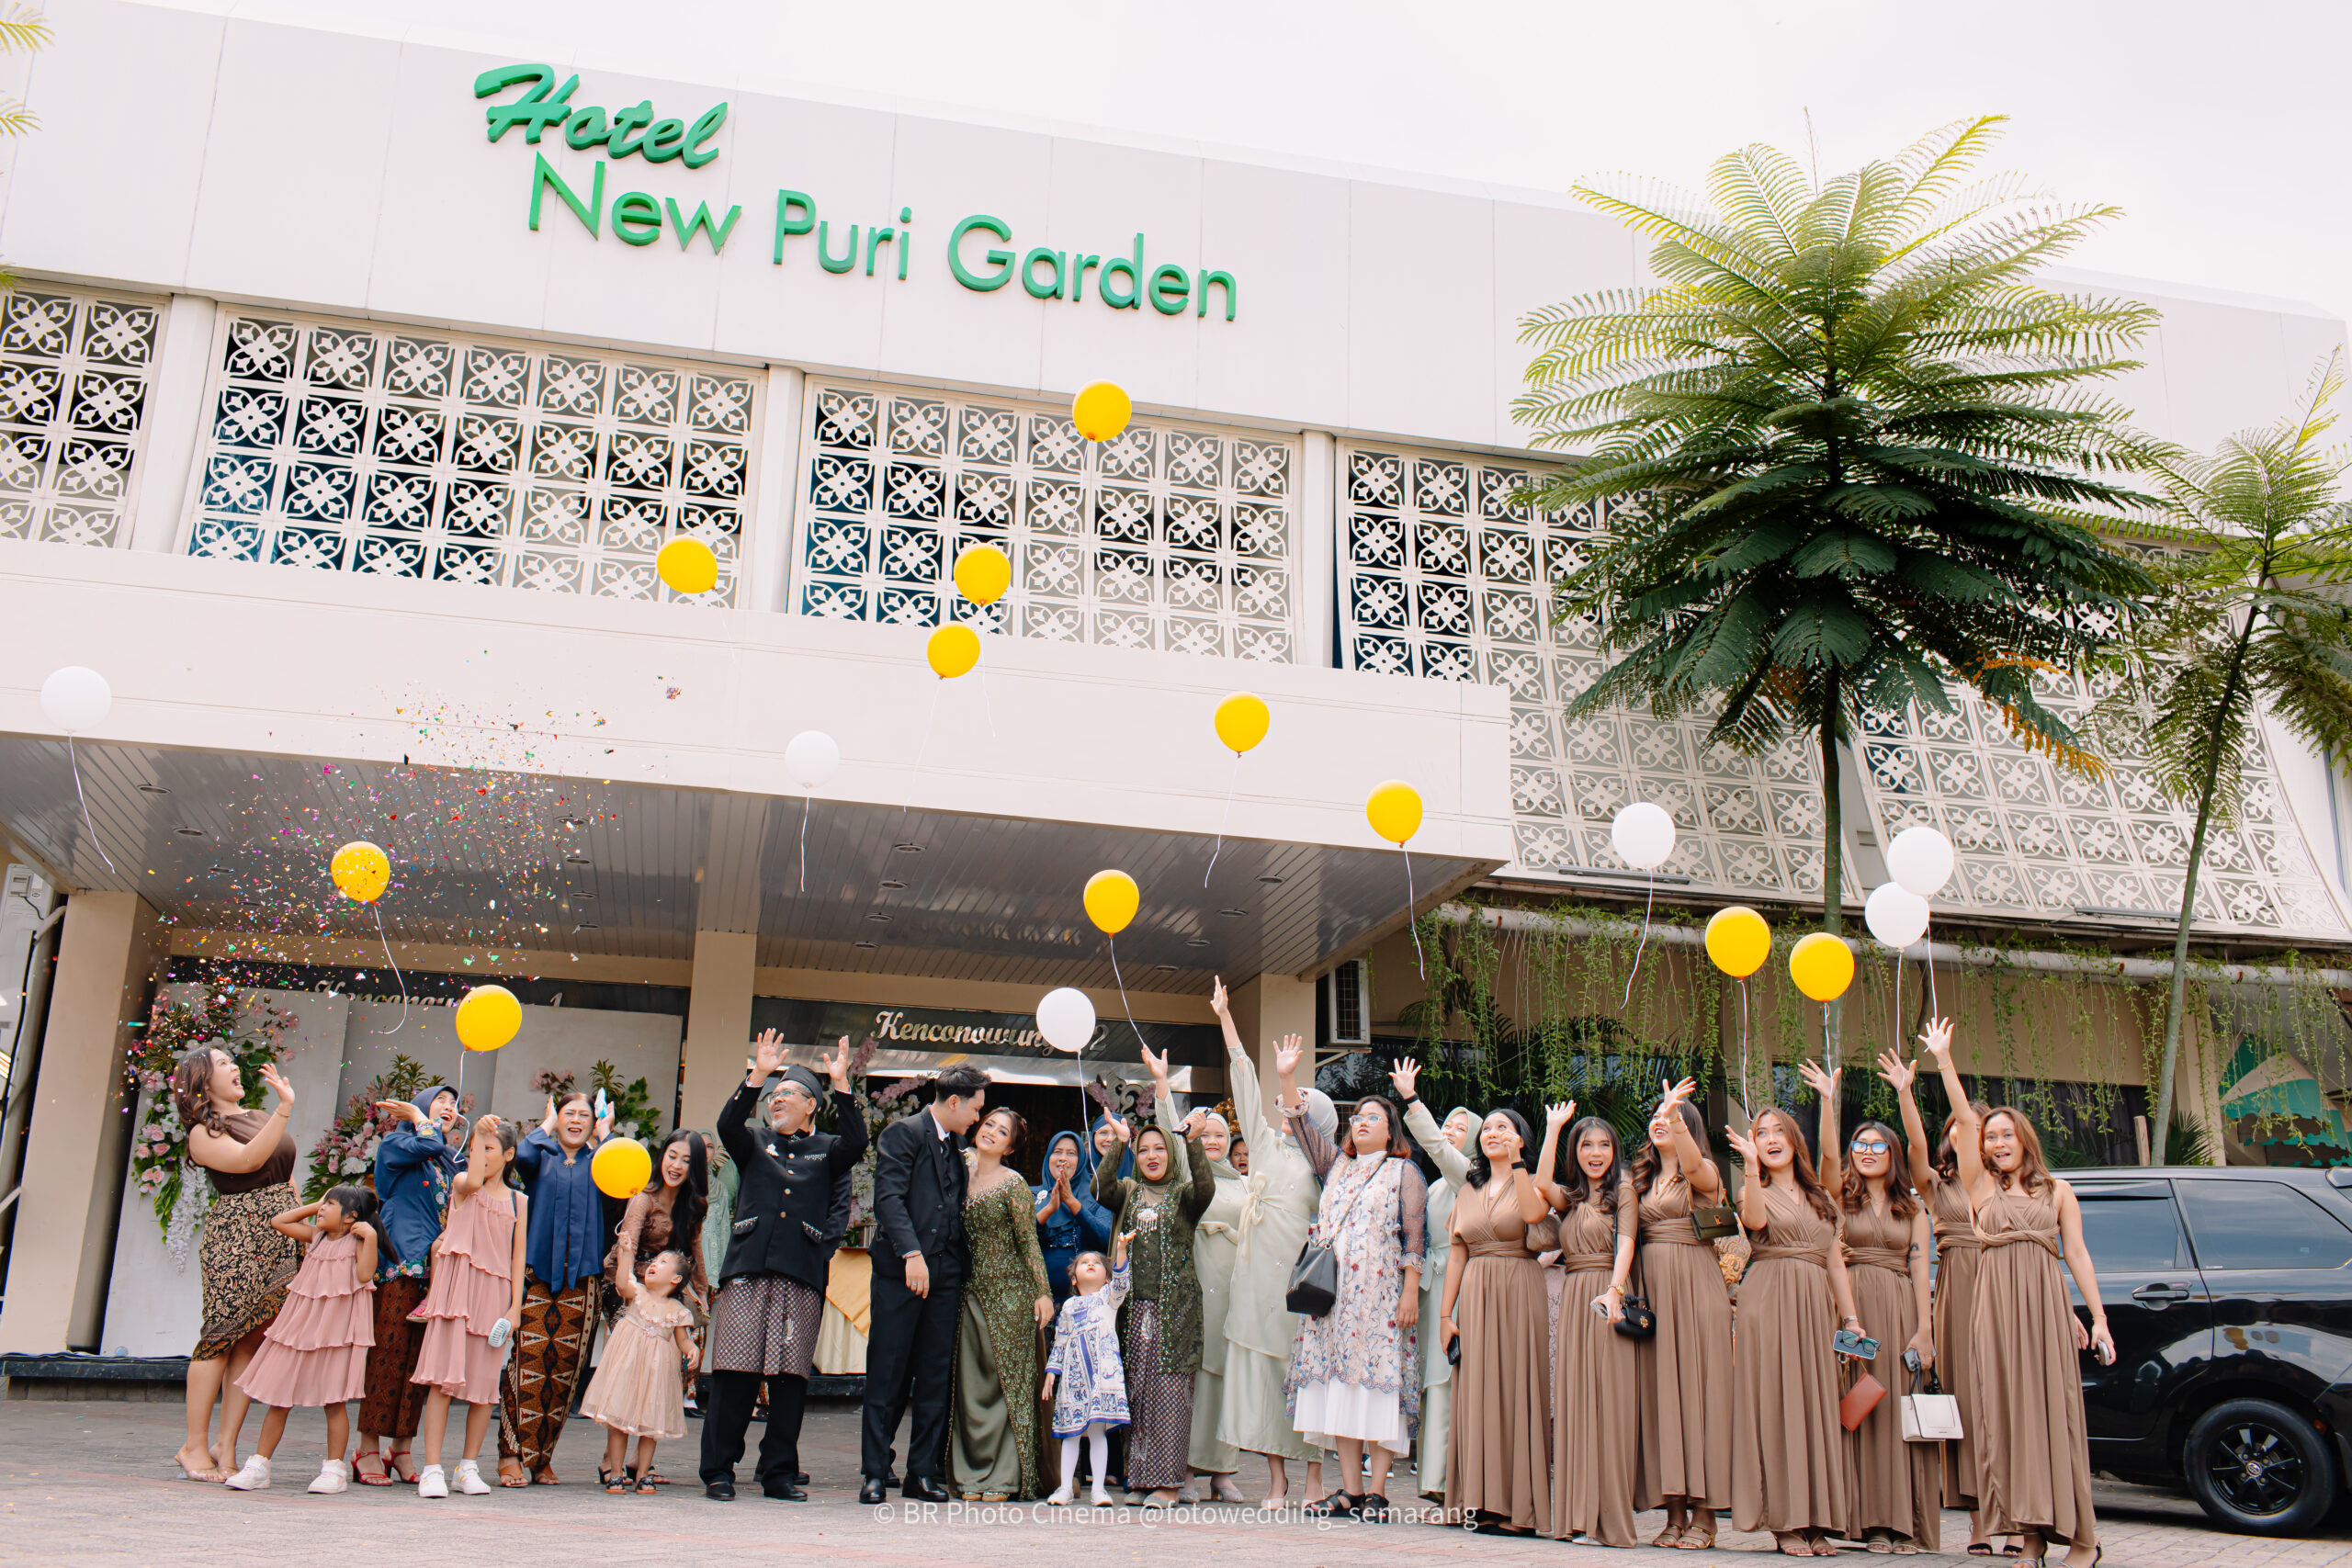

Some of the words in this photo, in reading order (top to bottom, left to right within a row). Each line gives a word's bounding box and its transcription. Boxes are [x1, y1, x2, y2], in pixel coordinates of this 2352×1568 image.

[473, 63, 729, 169] Hotel
[528, 150, 742, 254] New
[773, 188, 911, 281] Puri
[948, 213, 1237, 321] Garden
[1088, 1023, 1110, 1052] 2
